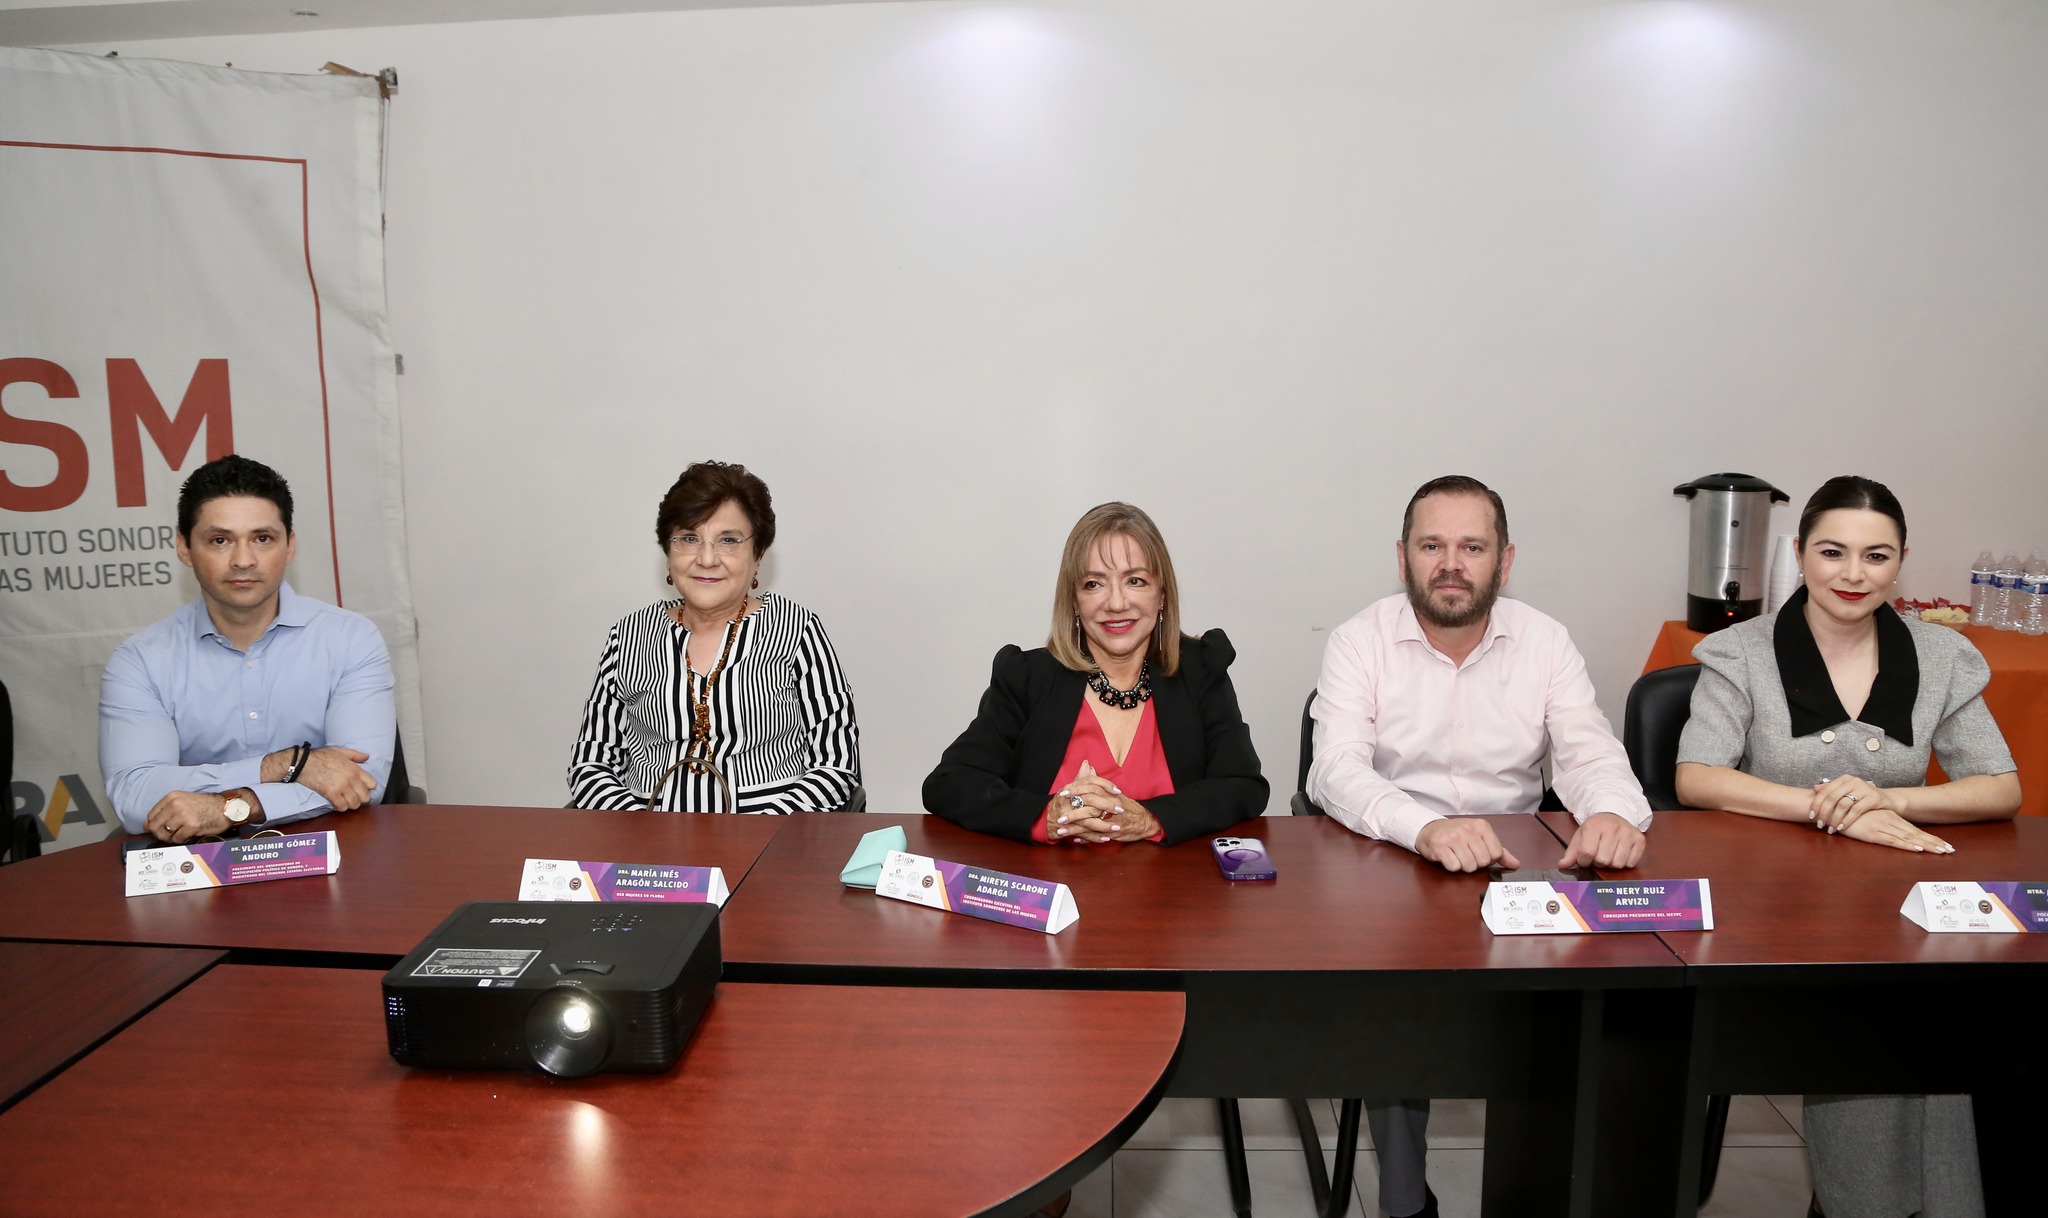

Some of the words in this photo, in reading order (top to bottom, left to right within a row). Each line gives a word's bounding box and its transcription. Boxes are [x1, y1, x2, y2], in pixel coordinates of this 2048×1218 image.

[78, 526, 178, 553] SONOR
[44, 561, 172, 591] MUJERES
[242, 842, 284, 852] VLADIMIR
[286, 838, 316, 848] GÓMEZ
[242, 852, 279, 861] ANDURO
[631, 869, 657, 878] MARÍA
[660, 870, 679, 878] INÉS
[616, 878, 650, 887] ARAGÓN
[653, 880, 689, 889] SALCIDO
[980, 876, 1009, 888] MIREYA
[1011, 882, 1048, 895] SCARONE
[977, 885, 1008, 898] ADARGA
